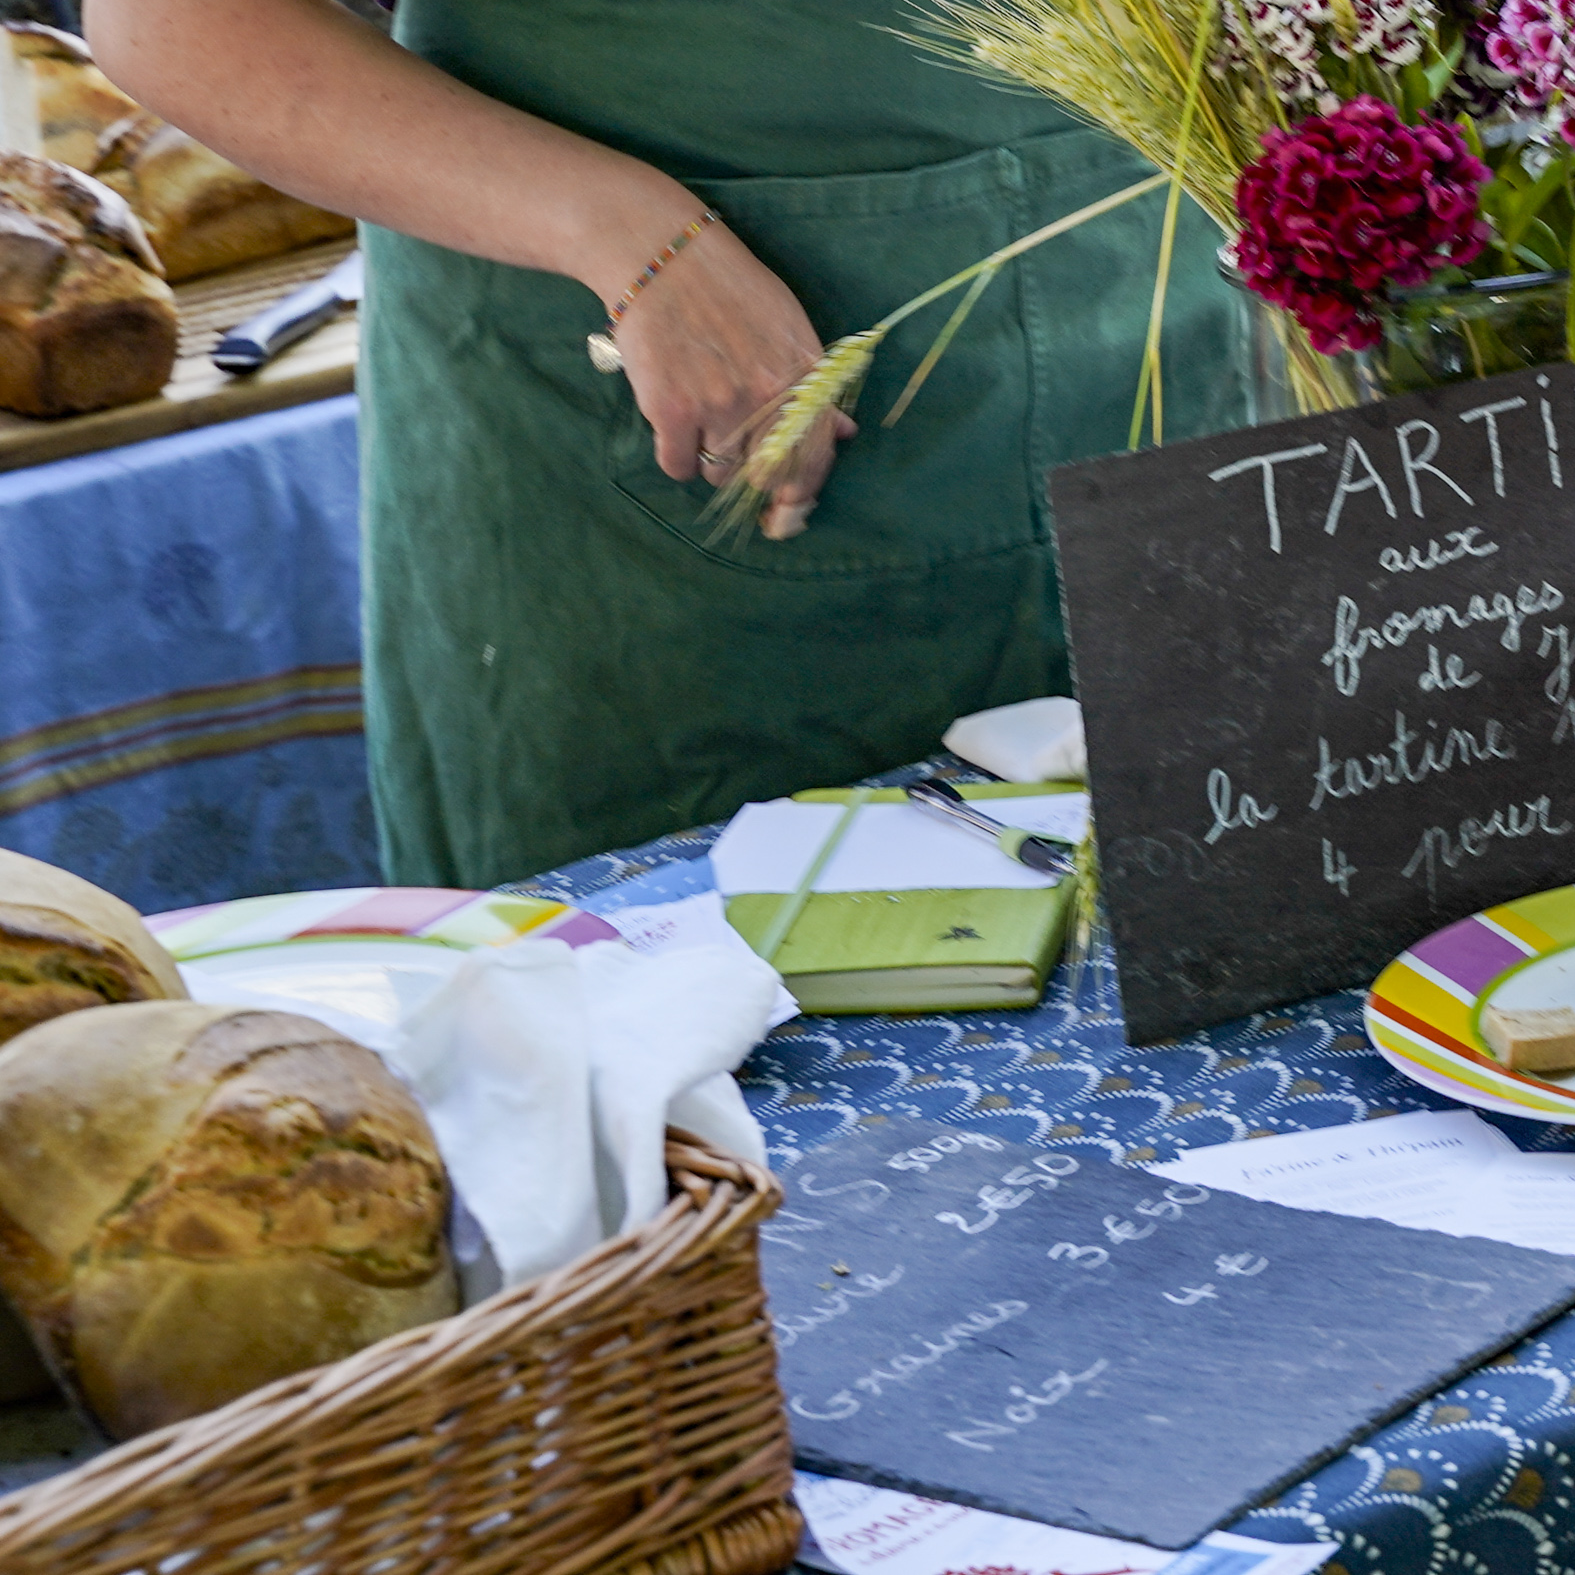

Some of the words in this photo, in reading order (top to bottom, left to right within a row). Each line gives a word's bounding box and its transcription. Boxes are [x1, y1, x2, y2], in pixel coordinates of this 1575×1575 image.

[1379, 526, 1499, 573] aux
[1321, 580, 1564, 697] fromages
[1418, 644, 1482, 692] de
[1204, 768, 1279, 844] la
[1309, 709, 1517, 811] tartine
[1321, 837, 1358, 897] 4
[1401, 794, 1570, 914] pour
[943, 1358, 1108, 1452] Noix
